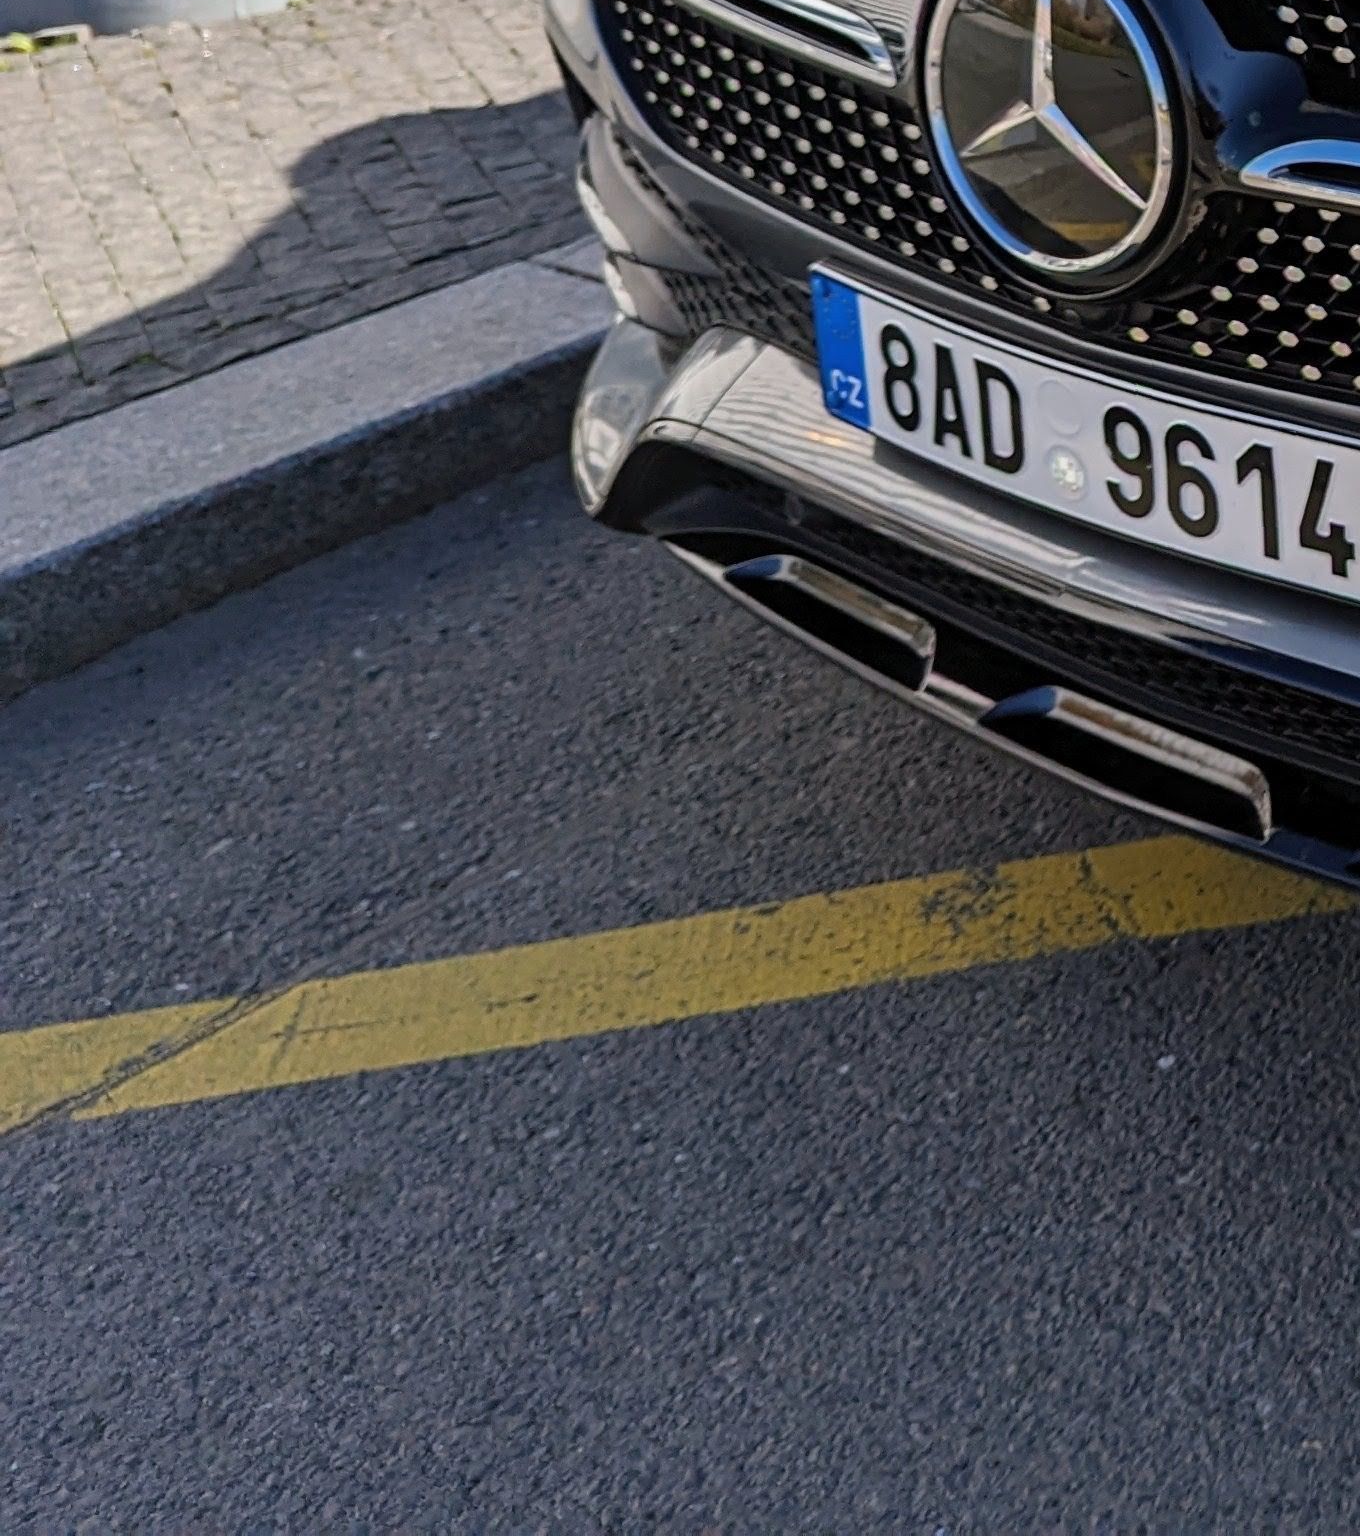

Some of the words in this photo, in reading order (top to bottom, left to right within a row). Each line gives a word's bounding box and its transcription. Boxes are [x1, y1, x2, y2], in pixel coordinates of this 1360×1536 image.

[829, 368, 865, 409] CZ
[879, 323, 1025, 474] 8AD
[1102, 405, 1357, 579] 9614
